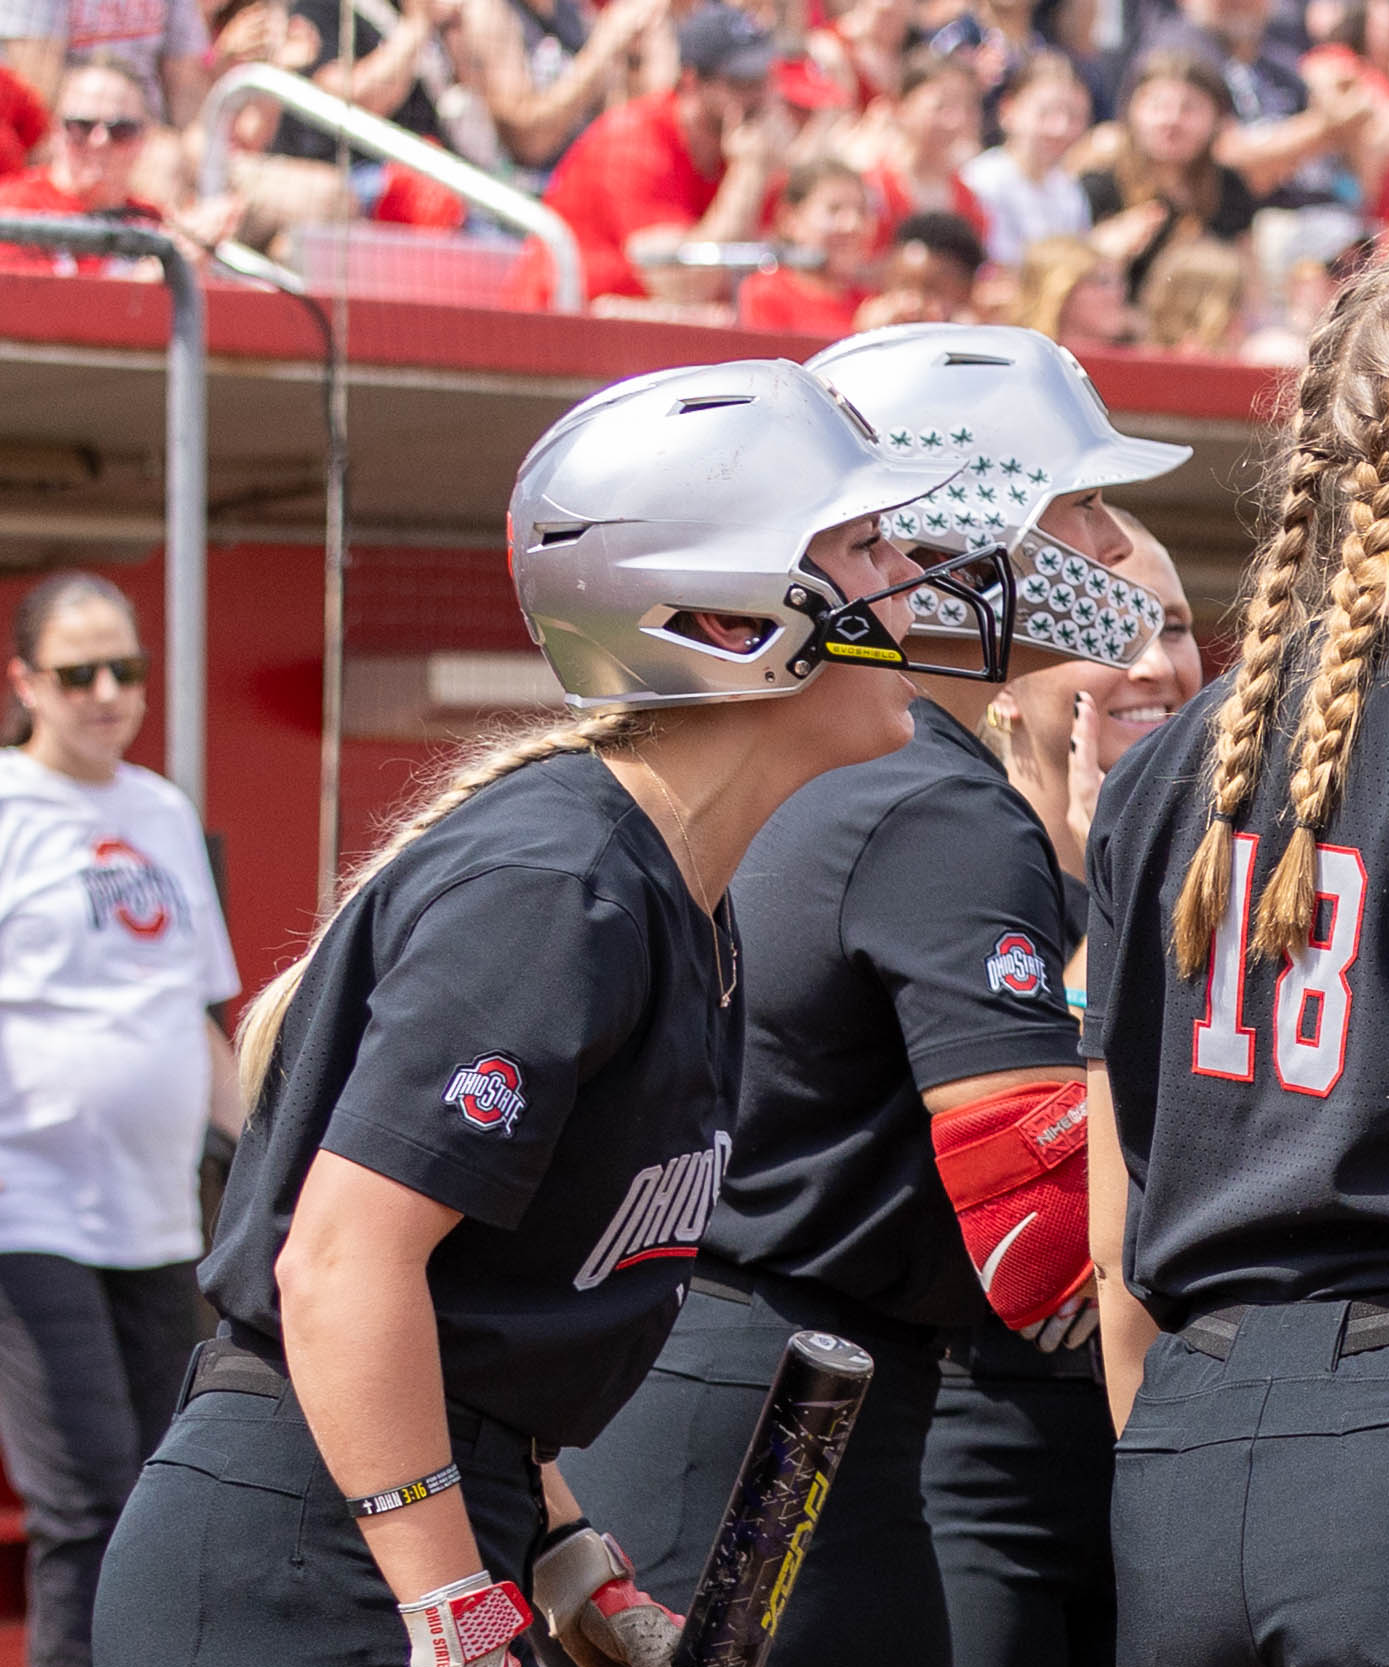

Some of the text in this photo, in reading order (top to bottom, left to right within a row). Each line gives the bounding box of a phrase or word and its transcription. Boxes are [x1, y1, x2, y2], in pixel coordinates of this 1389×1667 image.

[1191, 832, 1369, 1098] 18
[444, 1071, 490, 1101] OHIO
[573, 1148, 714, 1292] OHIO
[374, 1482, 428, 1513] JOHN 3:16
[424, 1606, 444, 1635] OHIO
